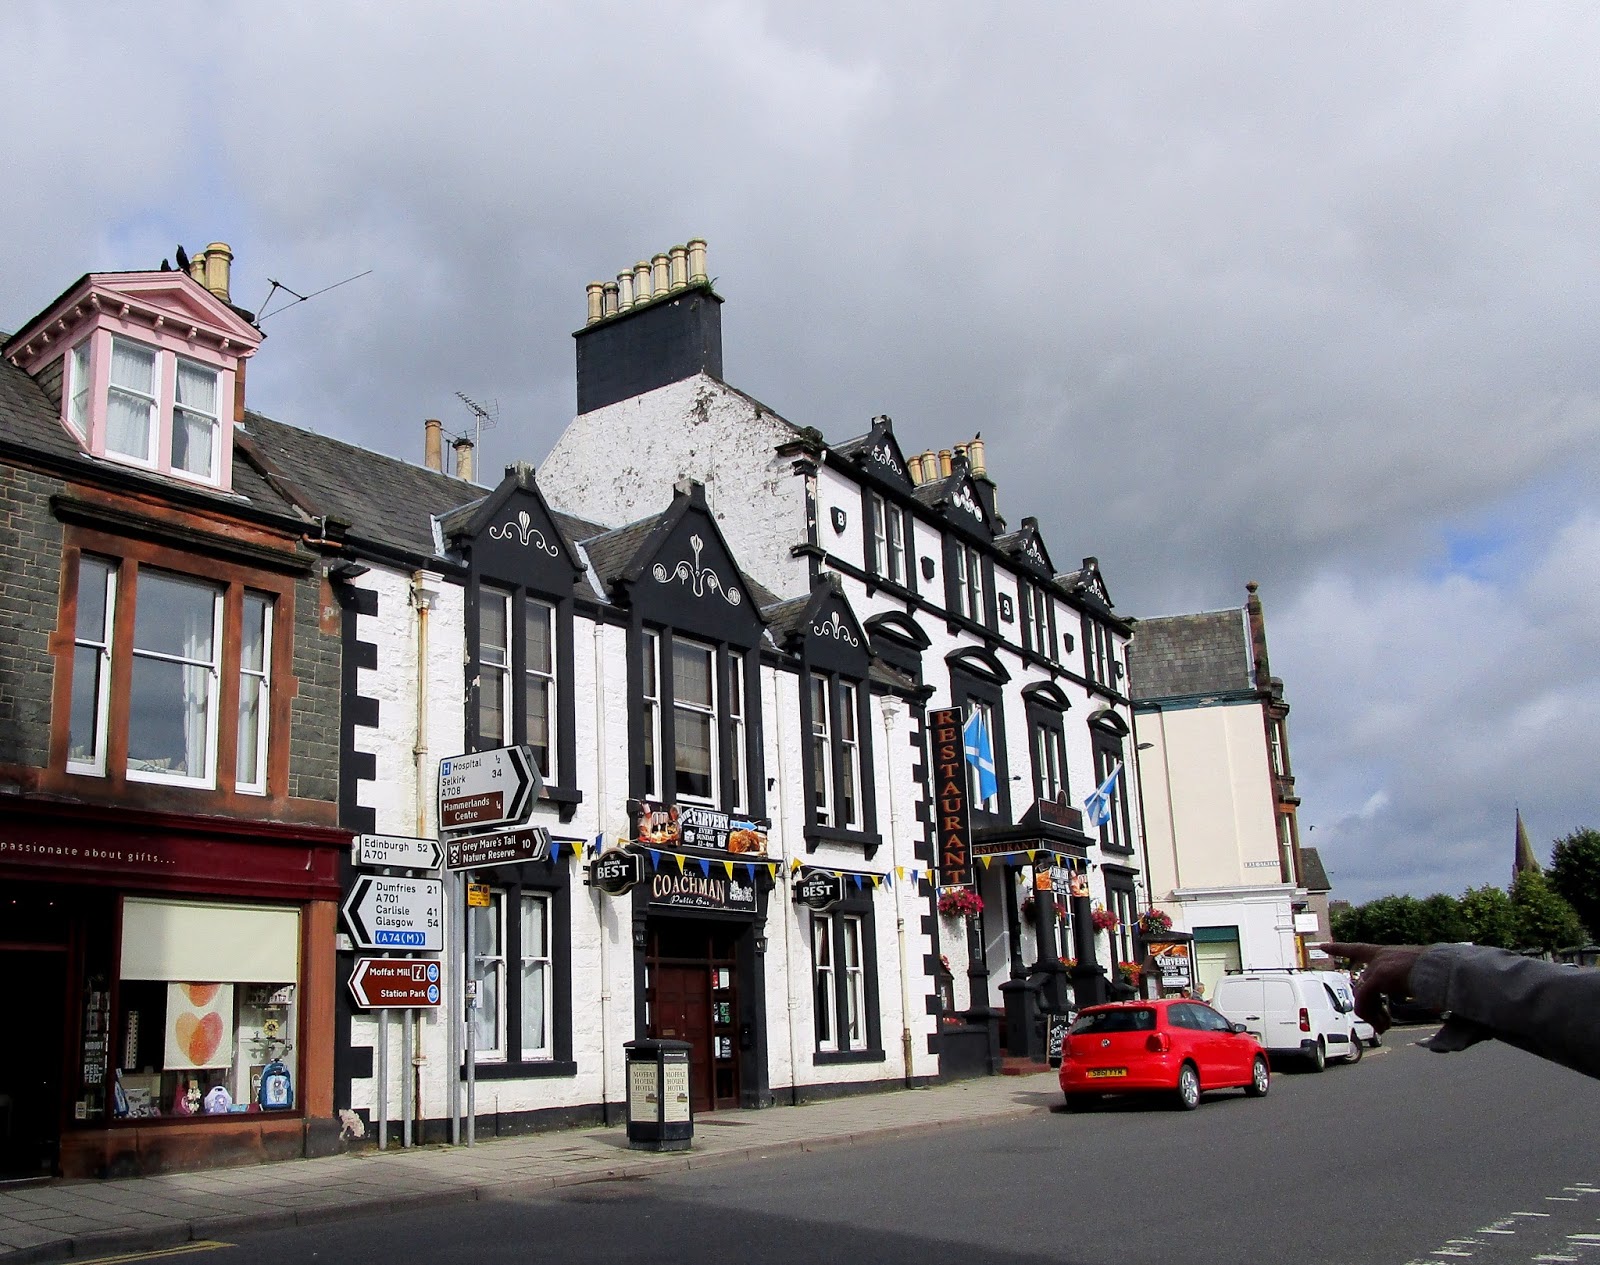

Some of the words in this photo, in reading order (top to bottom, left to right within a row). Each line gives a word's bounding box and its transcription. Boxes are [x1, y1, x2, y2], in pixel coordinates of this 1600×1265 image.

[453, 758, 482, 771] Hospital
[442, 775, 466, 787] Selkirk
[492, 769, 502, 778] 34
[441, 786, 461, 797] A708
[935, 711, 966, 884] RESTAURANT
[443, 797, 490, 812] Hammerlands
[454, 810, 478, 821] Centre
[691, 810, 729, 829] CARVERY
[364, 839, 409, 852] Edinburgh
[417, 844, 428, 853] 52
[462, 841, 479, 852] Grey
[480, 837, 502, 849] Mare's
[503, 834, 516, 846] Tail
[522, 838, 531, 849] 10
[974, 841, 1036, 855] ESTAURANT
[0, 841, 78, 857] passionate
[84, 848, 122, 860] about
[364, 850, 387, 860] A701
[463, 851, 486, 863] Nature
[488, 849, 516, 859] Reserve
[597, 865, 629, 879] BEST
[683, 869, 696, 877] The
[376, 882, 416, 893] Dumfries
[427, 885, 437, 894] 21
[653, 874, 725, 904] COACHMAN
[802, 885, 833, 897] BEST
[376, 894, 399, 903] A701
[670, 895, 694, 904] Public
[695, 897, 710, 905] Bar
[376, 905, 410, 915] Carlisle
[426, 908, 437, 916] 41
[375, 916, 413, 928] Glasgow
[427, 919, 439, 928] 54
[376, 932, 425, 944] (A74(M))
[1157, 958, 1188, 966] CARVERY
[369, 968, 395, 976] Moffat
[397, 968, 411, 976] Mill
[381, 990, 408, 998] Station
[410, 990, 426, 998] Park
[84, 1064, 103, 1074] PER-
[84, 1073, 103, 1084] FECT
